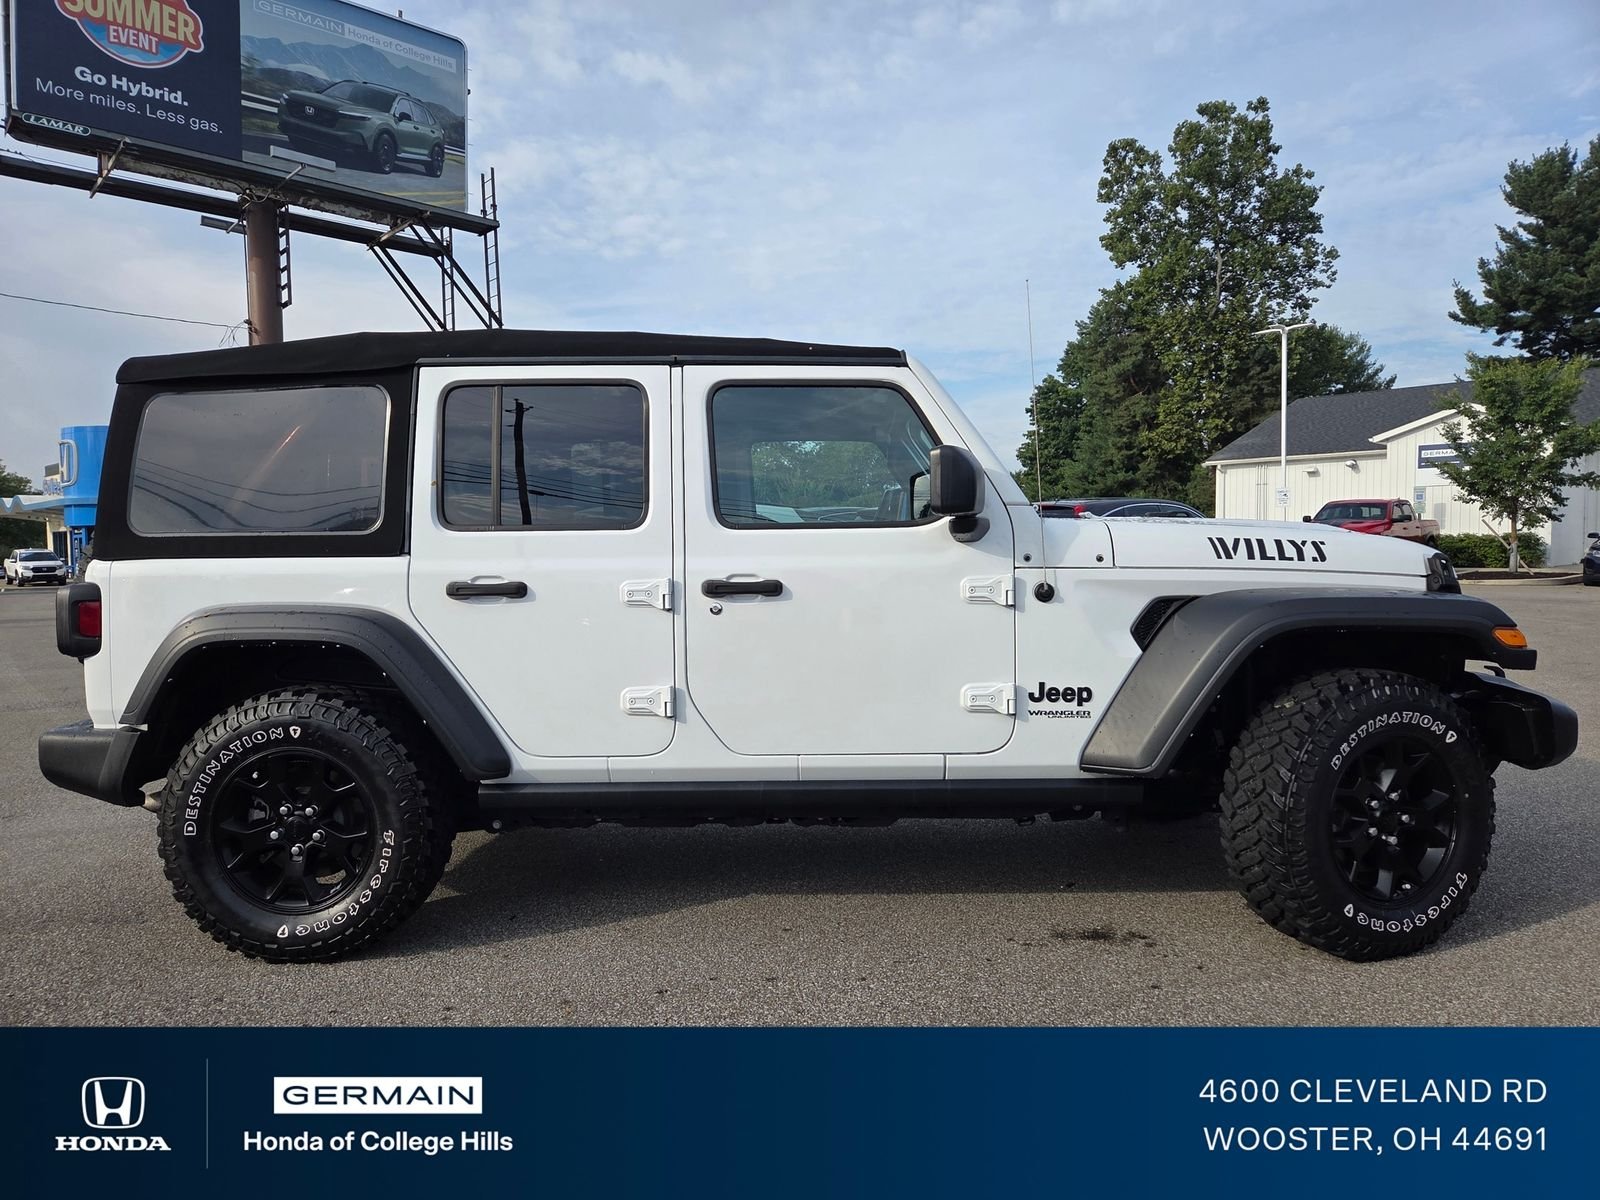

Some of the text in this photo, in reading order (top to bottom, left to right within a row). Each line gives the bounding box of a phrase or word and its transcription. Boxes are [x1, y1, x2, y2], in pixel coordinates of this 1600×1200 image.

[258, 0, 343, 33] GERMAIN
[109, 25, 158, 53] EVENT
[348, 27, 453, 69] Honda of College Hills
[36, 77, 223, 134] More miles. Less gas.
[74, 66, 189, 106] Go Hybrid.
[30, 115, 84, 134] LAMAR
[1208, 537, 1326, 562] WILLYS
[1028, 682, 1093, 707] Jeep
[1330, 711, 1446, 770] DESTINATION
[183, 727, 284, 836] DESTINATION
[295, 829, 395, 937] Firestone
[1356, 872, 1468, 933] Firestone
